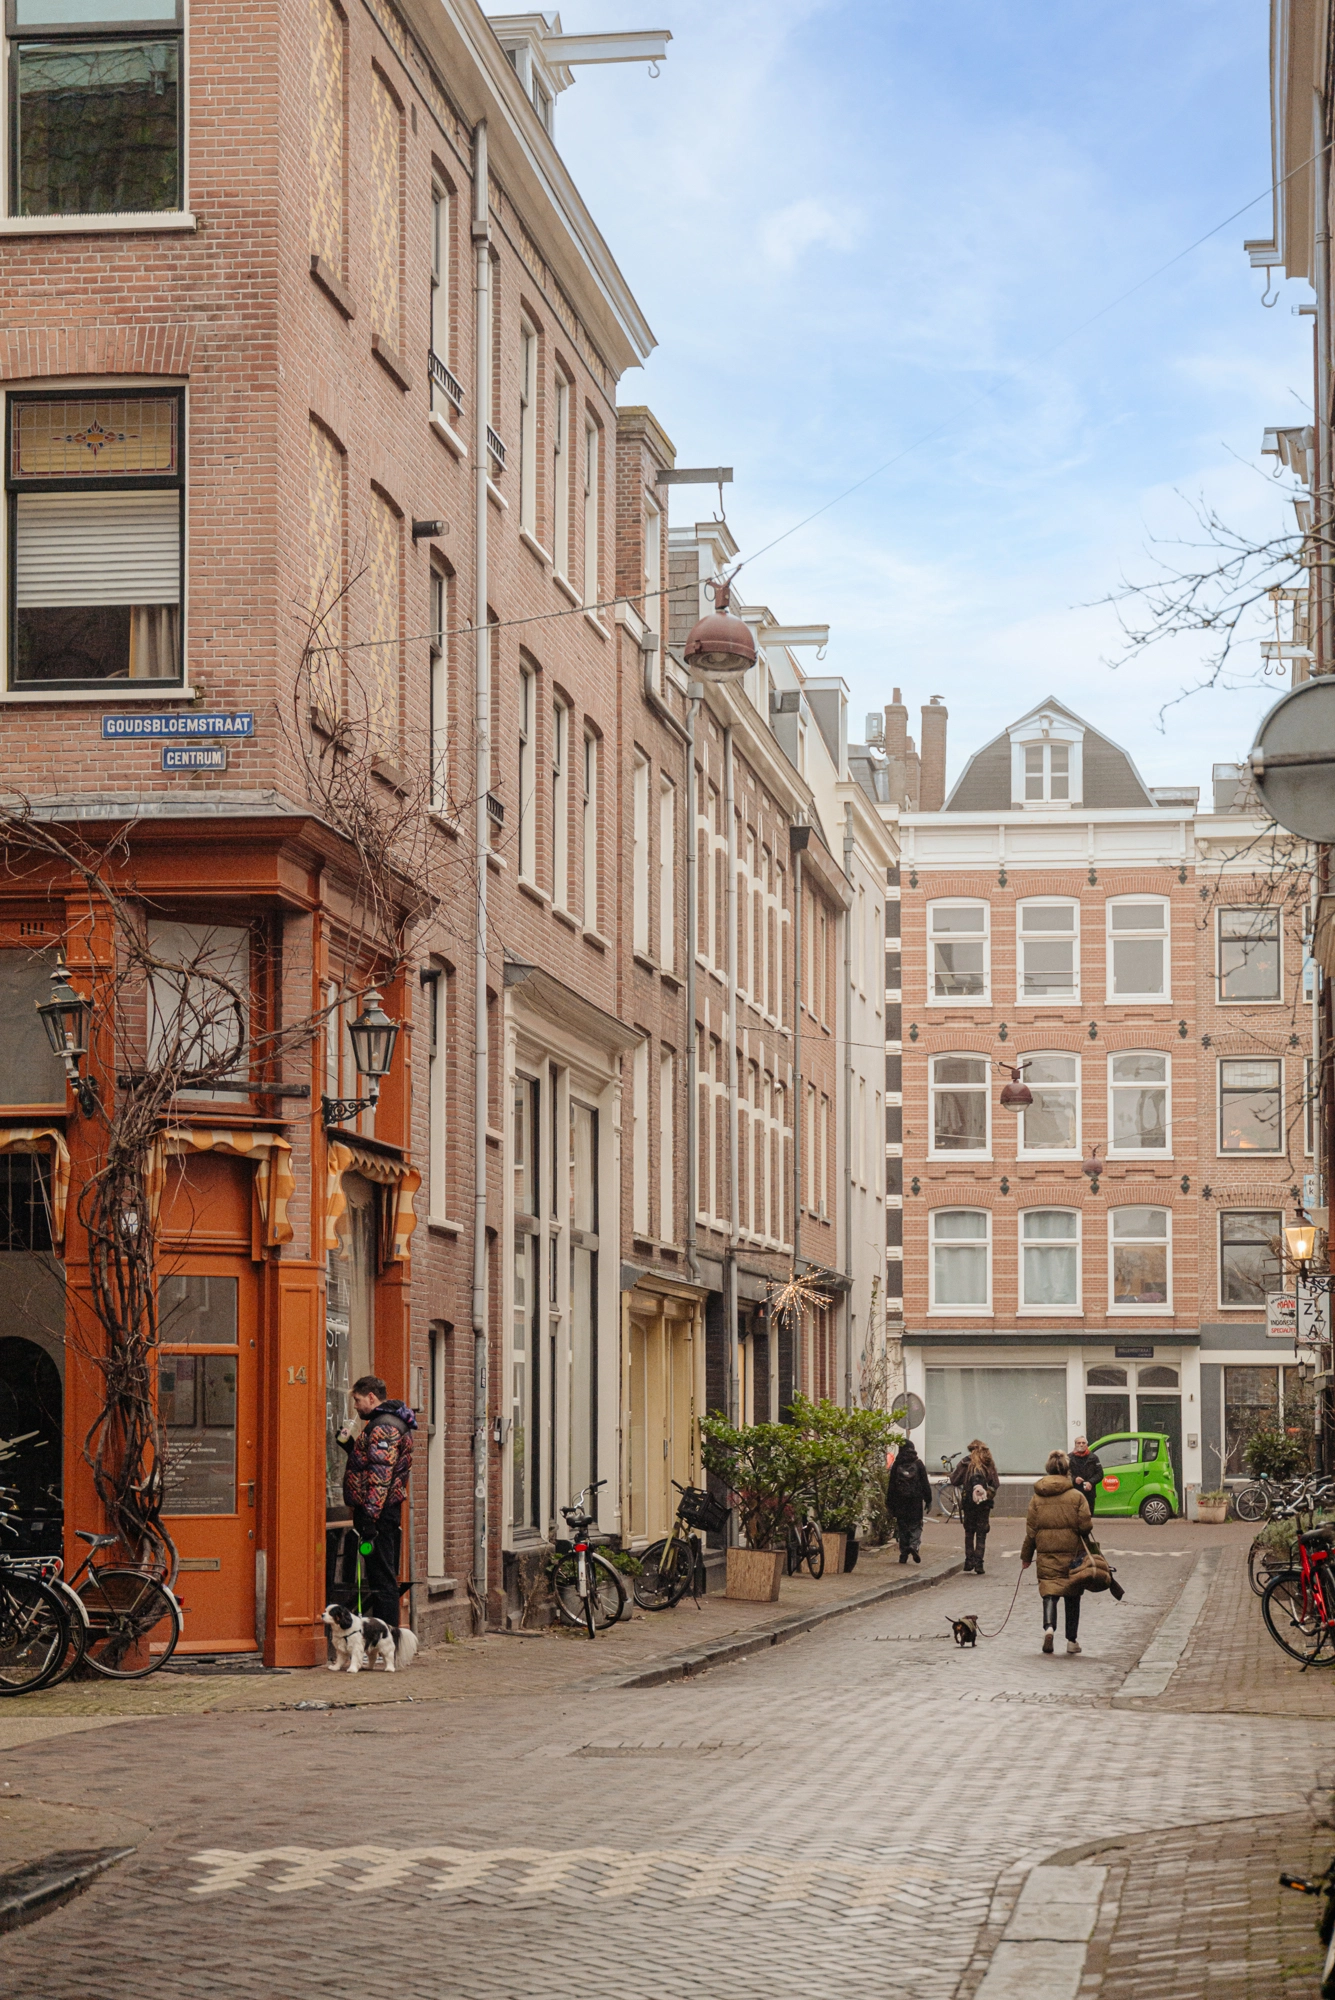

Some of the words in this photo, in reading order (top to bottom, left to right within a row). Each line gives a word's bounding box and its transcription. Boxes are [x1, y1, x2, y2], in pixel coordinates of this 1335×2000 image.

[107, 717, 251, 733] GOUDSBLOEMSTRAAT
[166, 751, 222, 765] CENTRUM
[287, 1365, 307, 1385] 14
